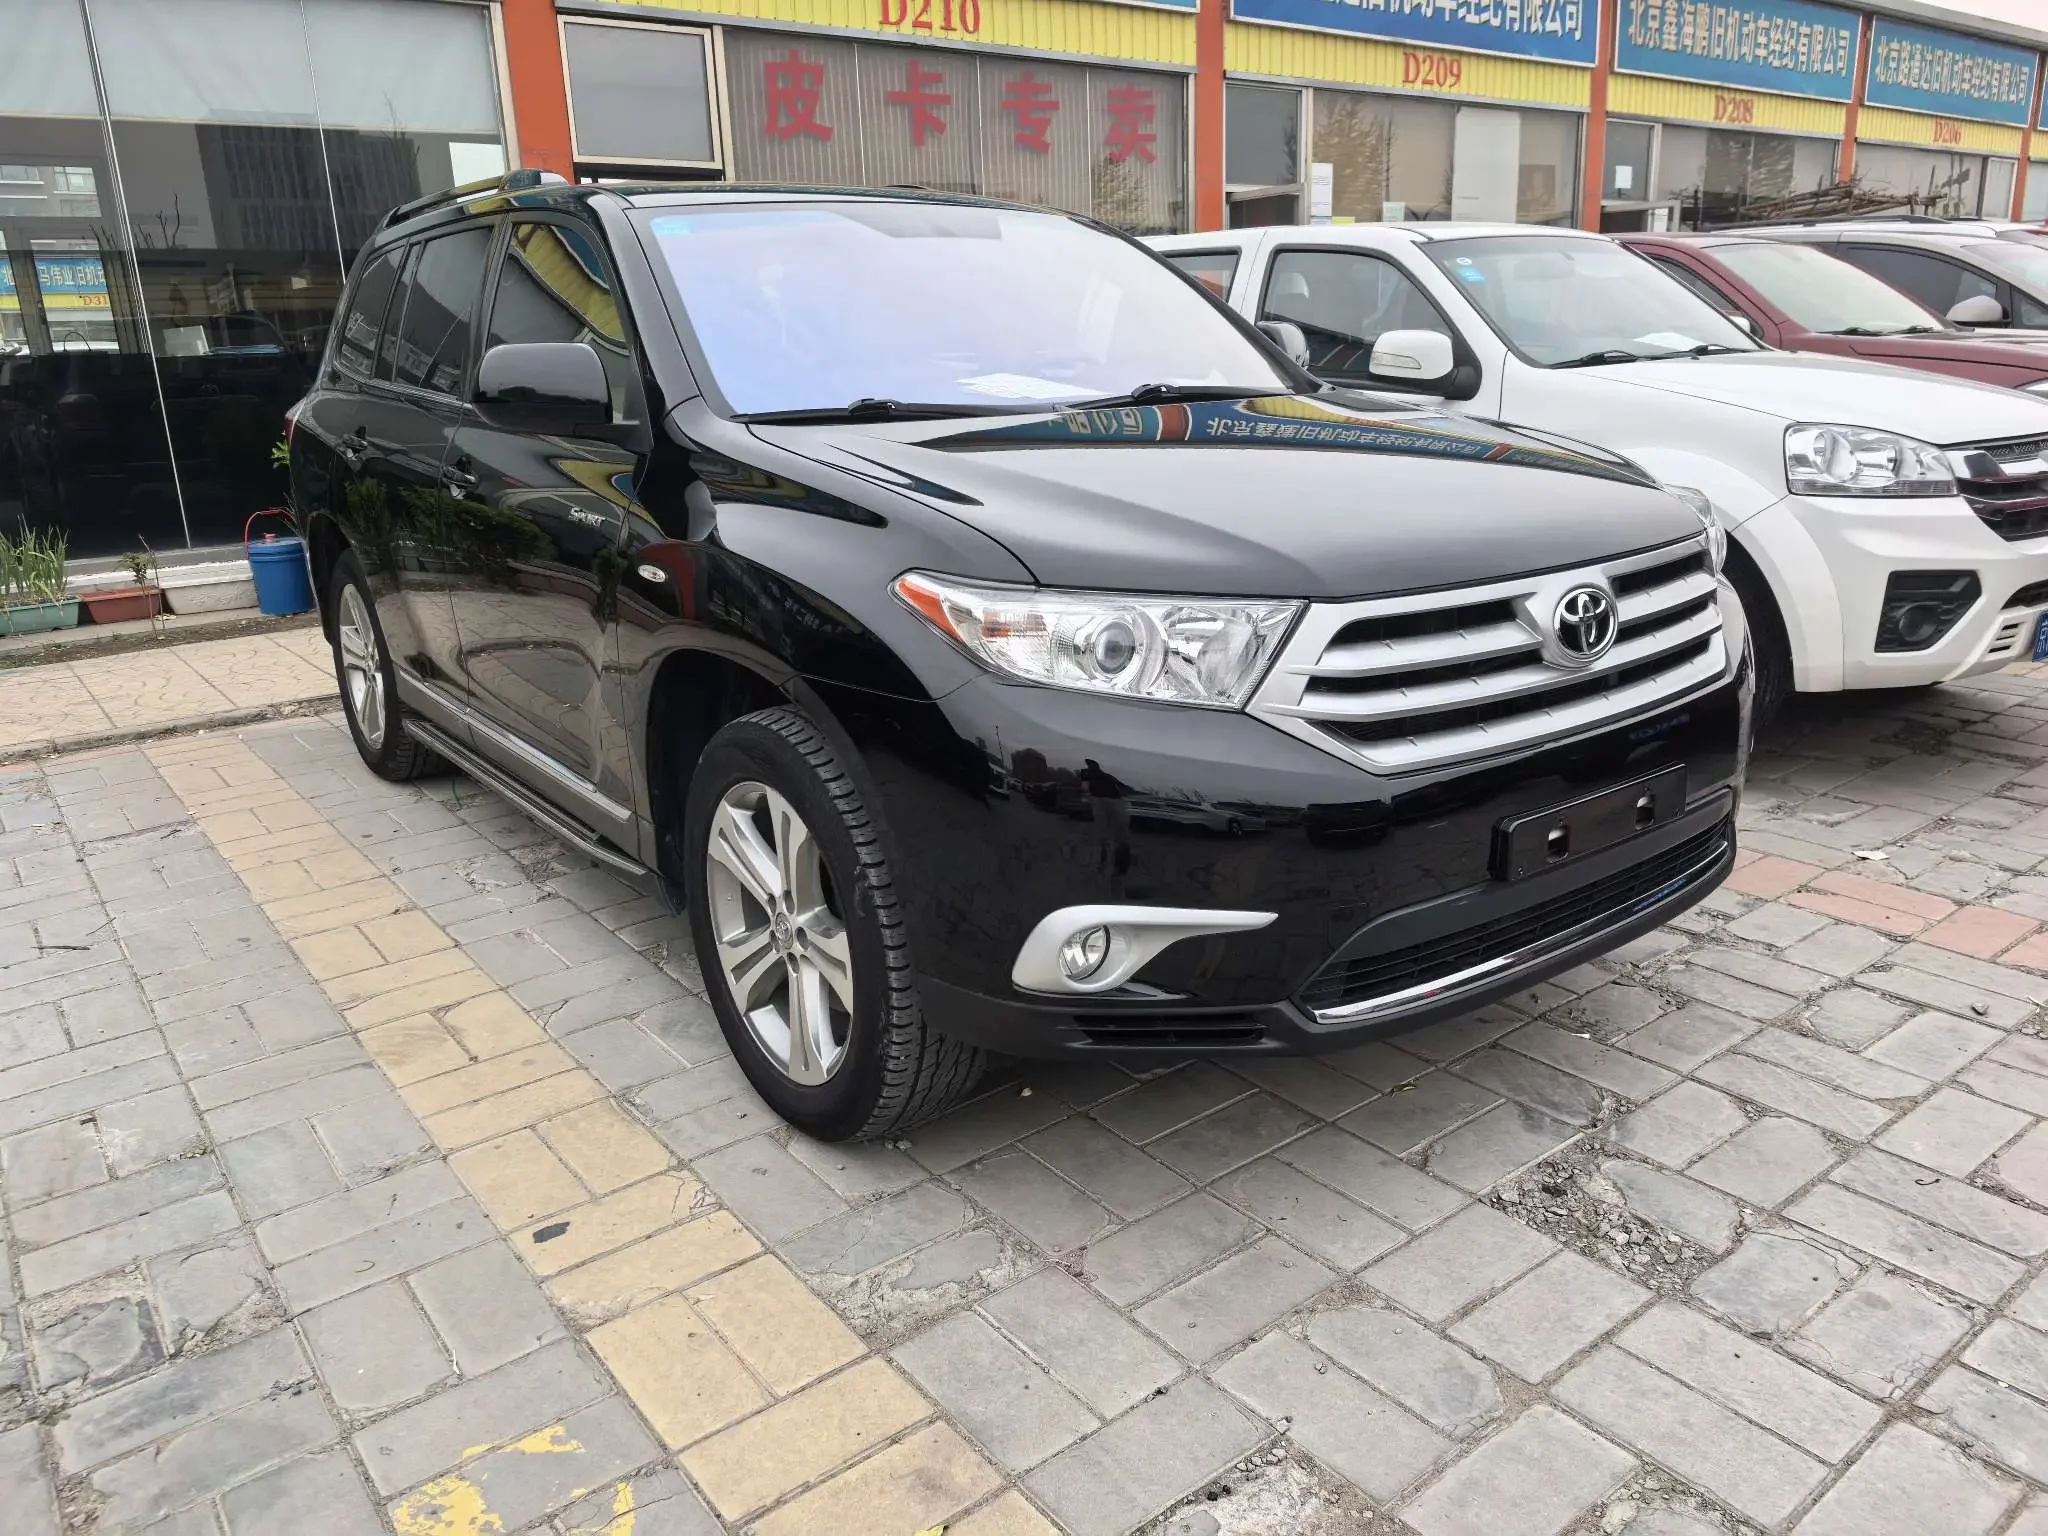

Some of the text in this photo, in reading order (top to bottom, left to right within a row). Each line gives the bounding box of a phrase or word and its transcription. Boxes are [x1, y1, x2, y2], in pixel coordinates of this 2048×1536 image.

[879, 0, 981, 34] D210
[1402, 51, 1462, 88] D209
[763, 49, 1157, 164] 皮卡专卖
[1713, 94, 1754, 124] D208
